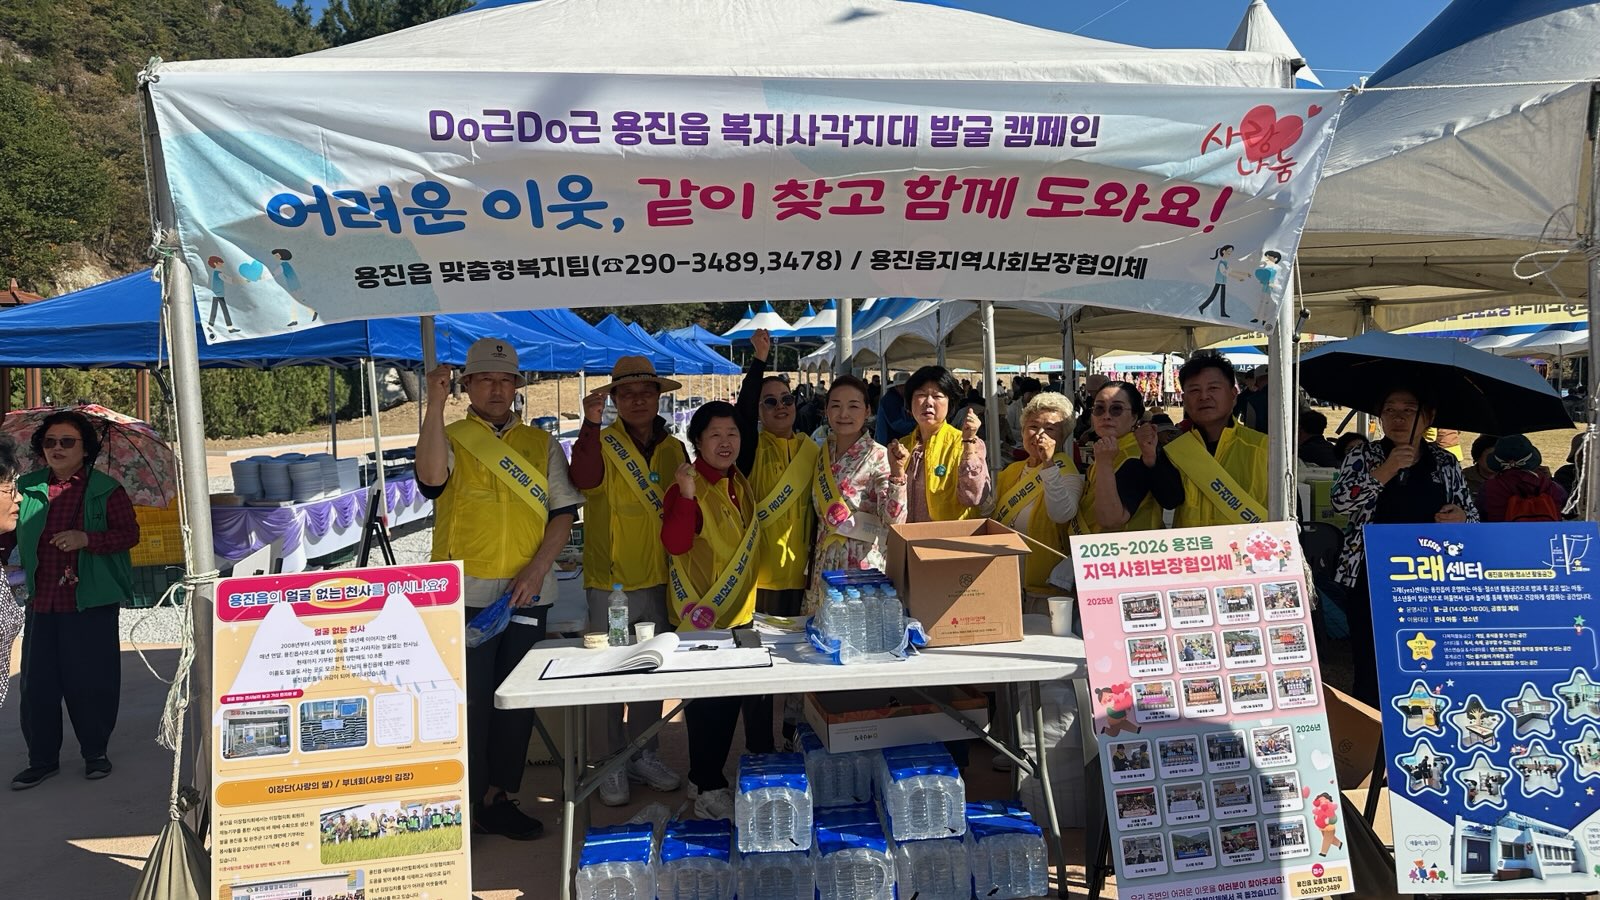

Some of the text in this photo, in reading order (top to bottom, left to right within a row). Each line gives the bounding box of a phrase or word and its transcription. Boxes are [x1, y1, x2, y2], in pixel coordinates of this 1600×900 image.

[429, 109, 1100, 148] Do근Do근 용진읍 복지사각지대 발굴 캠페인
[1200, 120, 1279, 155] 사랑
[1237, 148, 1298, 184] 나눔
[266, 174, 1233, 236] 어려운 이웃, 같이 찾고 함께 도와요!
[354, 260, 432, 288] 용진읍
[852, 251, 862, 270] /
[869, 250, 1148, 280] 용진읍지역사회보장협의체
[1210, 478, 1242, 510] 어려운
[1080, 535, 1212, 558] 2025~2026 용진읍
[1083, 554, 1232, 579] 지역사회보장협의체
[229, 579, 448, 607] 용진읍의 얼굴 없는 천사를 아시나요?
[1086, 597, 1113, 605] 2025년
[314, 624, 365, 636] 얼굴 없는 천사
[1296, 724, 1320, 732] 2026년
[268, 782, 319, 795] 이장단(사랑의
[321, 780, 333, 790] 쌀)
[342, 775, 393, 787] 부녀회(사랑의
[395, 772, 414, 782] 김장)
[1147, 890, 1169, 900] 주변의
[1171, 887, 1192, 898] 어려운
[1194, 884, 1216, 894] 이웃을
[1217, 881, 1246, 891] 여러분이
[1247, 876, 1285, 887] 찾아주세요!
